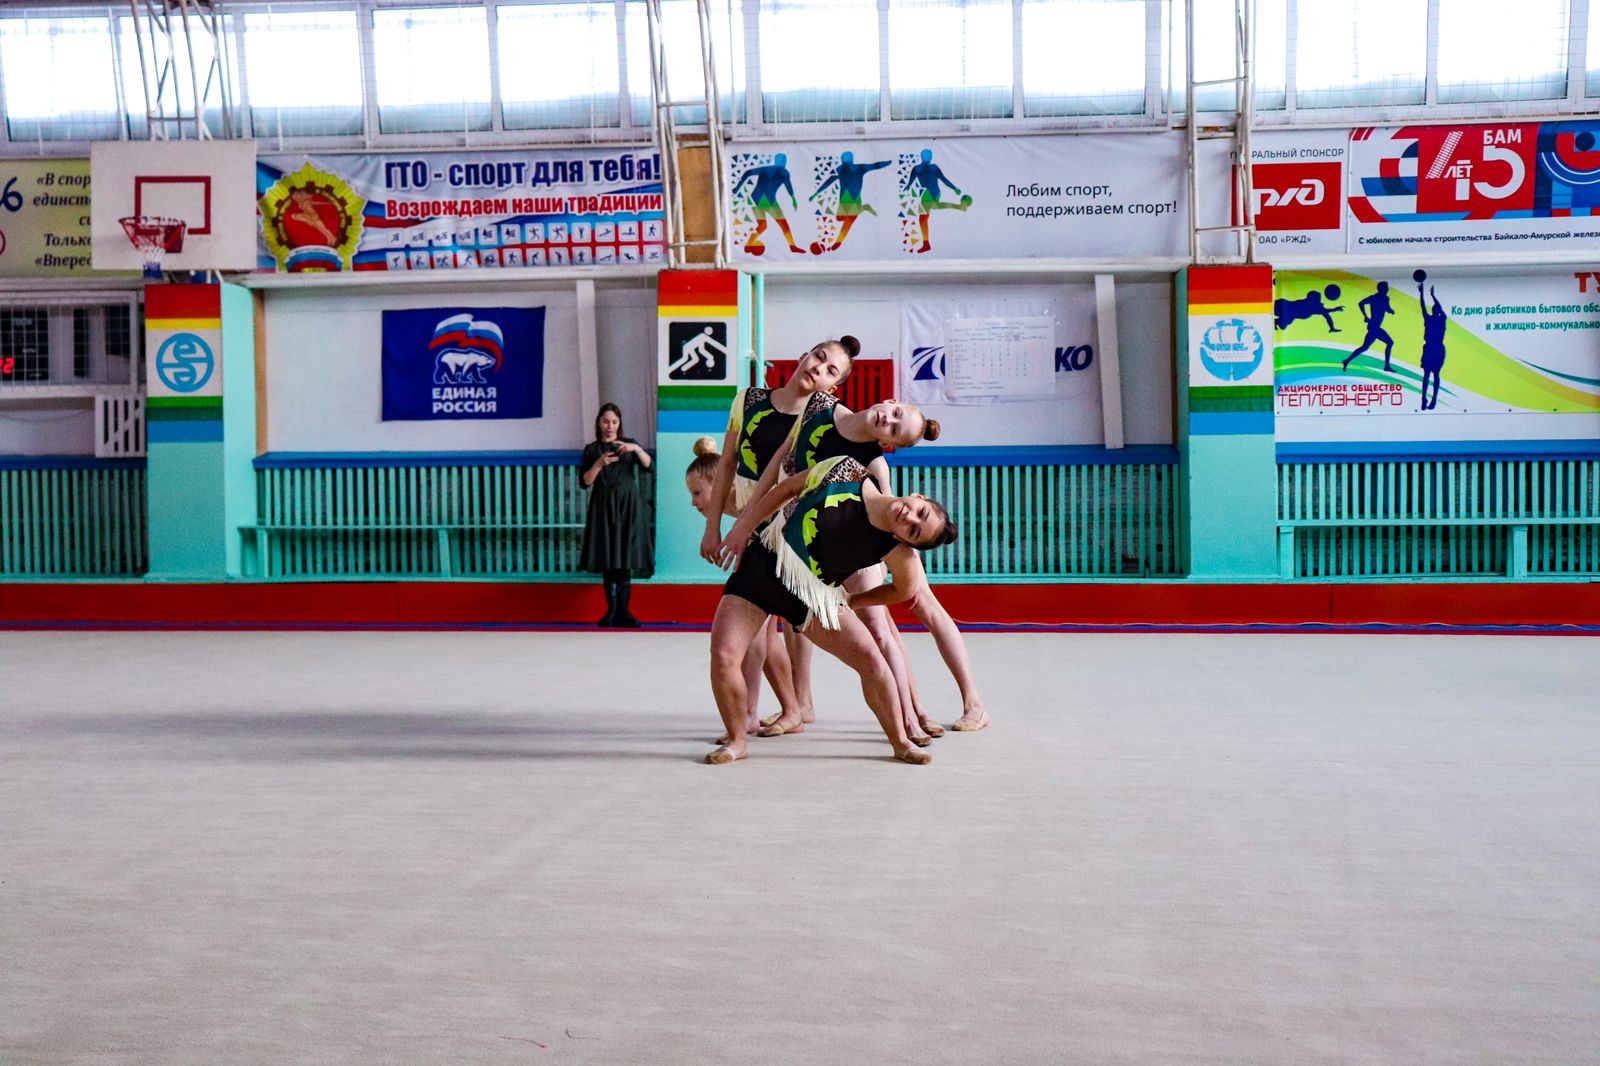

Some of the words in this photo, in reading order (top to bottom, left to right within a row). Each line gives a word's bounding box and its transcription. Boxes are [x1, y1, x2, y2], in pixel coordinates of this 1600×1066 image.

[1483, 129, 1522, 144] БАМ
[1300, 149, 1344, 159] СПОНСОР
[385, 161, 428, 189] ГТО
[449, 162, 526, 187] спорт
[532, 161, 583, 187] для
[589, 154, 661, 182] тебя!
[1444, 165, 1474, 179] ЛЕТ
[1006, 183, 1061, 198] Любим
[1066, 185, 1112, 199] спорт,
[386, 199, 508, 218] Возрождаем
[512, 197, 563, 214] наши
[568, 194, 662, 214] традиции
[1006, 204, 1124, 218] поддерживаем
[1128, 200, 1177, 217] спорт!
[1258, 236, 1277, 244] ОАО
[1280, 235, 1312, 244] «РЖД»
[1366, 236, 1402, 244] юбилеем
[1434, 234, 1492, 244] строительства
[1494, 231, 1571, 241] Байкало-Амурской
[1451, 305, 1463, 316] Ко
[1464, 307, 1483, 316] дню
[1485, 304, 1537, 316] работников
[1539, 303, 1581, 314] бытового
[1485, 323, 1491, 331] и
[1493, 319, 1600, 332] жилищно-коммунально
[432, 386, 497, 400] ЕДИНАЯ
[1278, 384, 1347, 393] АКЦИОНЕРНОЕ
[1352, 383, 1403, 392] ОБЩЕСТВО
[432, 401, 497, 413] РОССИЯ
[1278, 393, 1403, 407] ТЕПЛОЭНЕРГО
